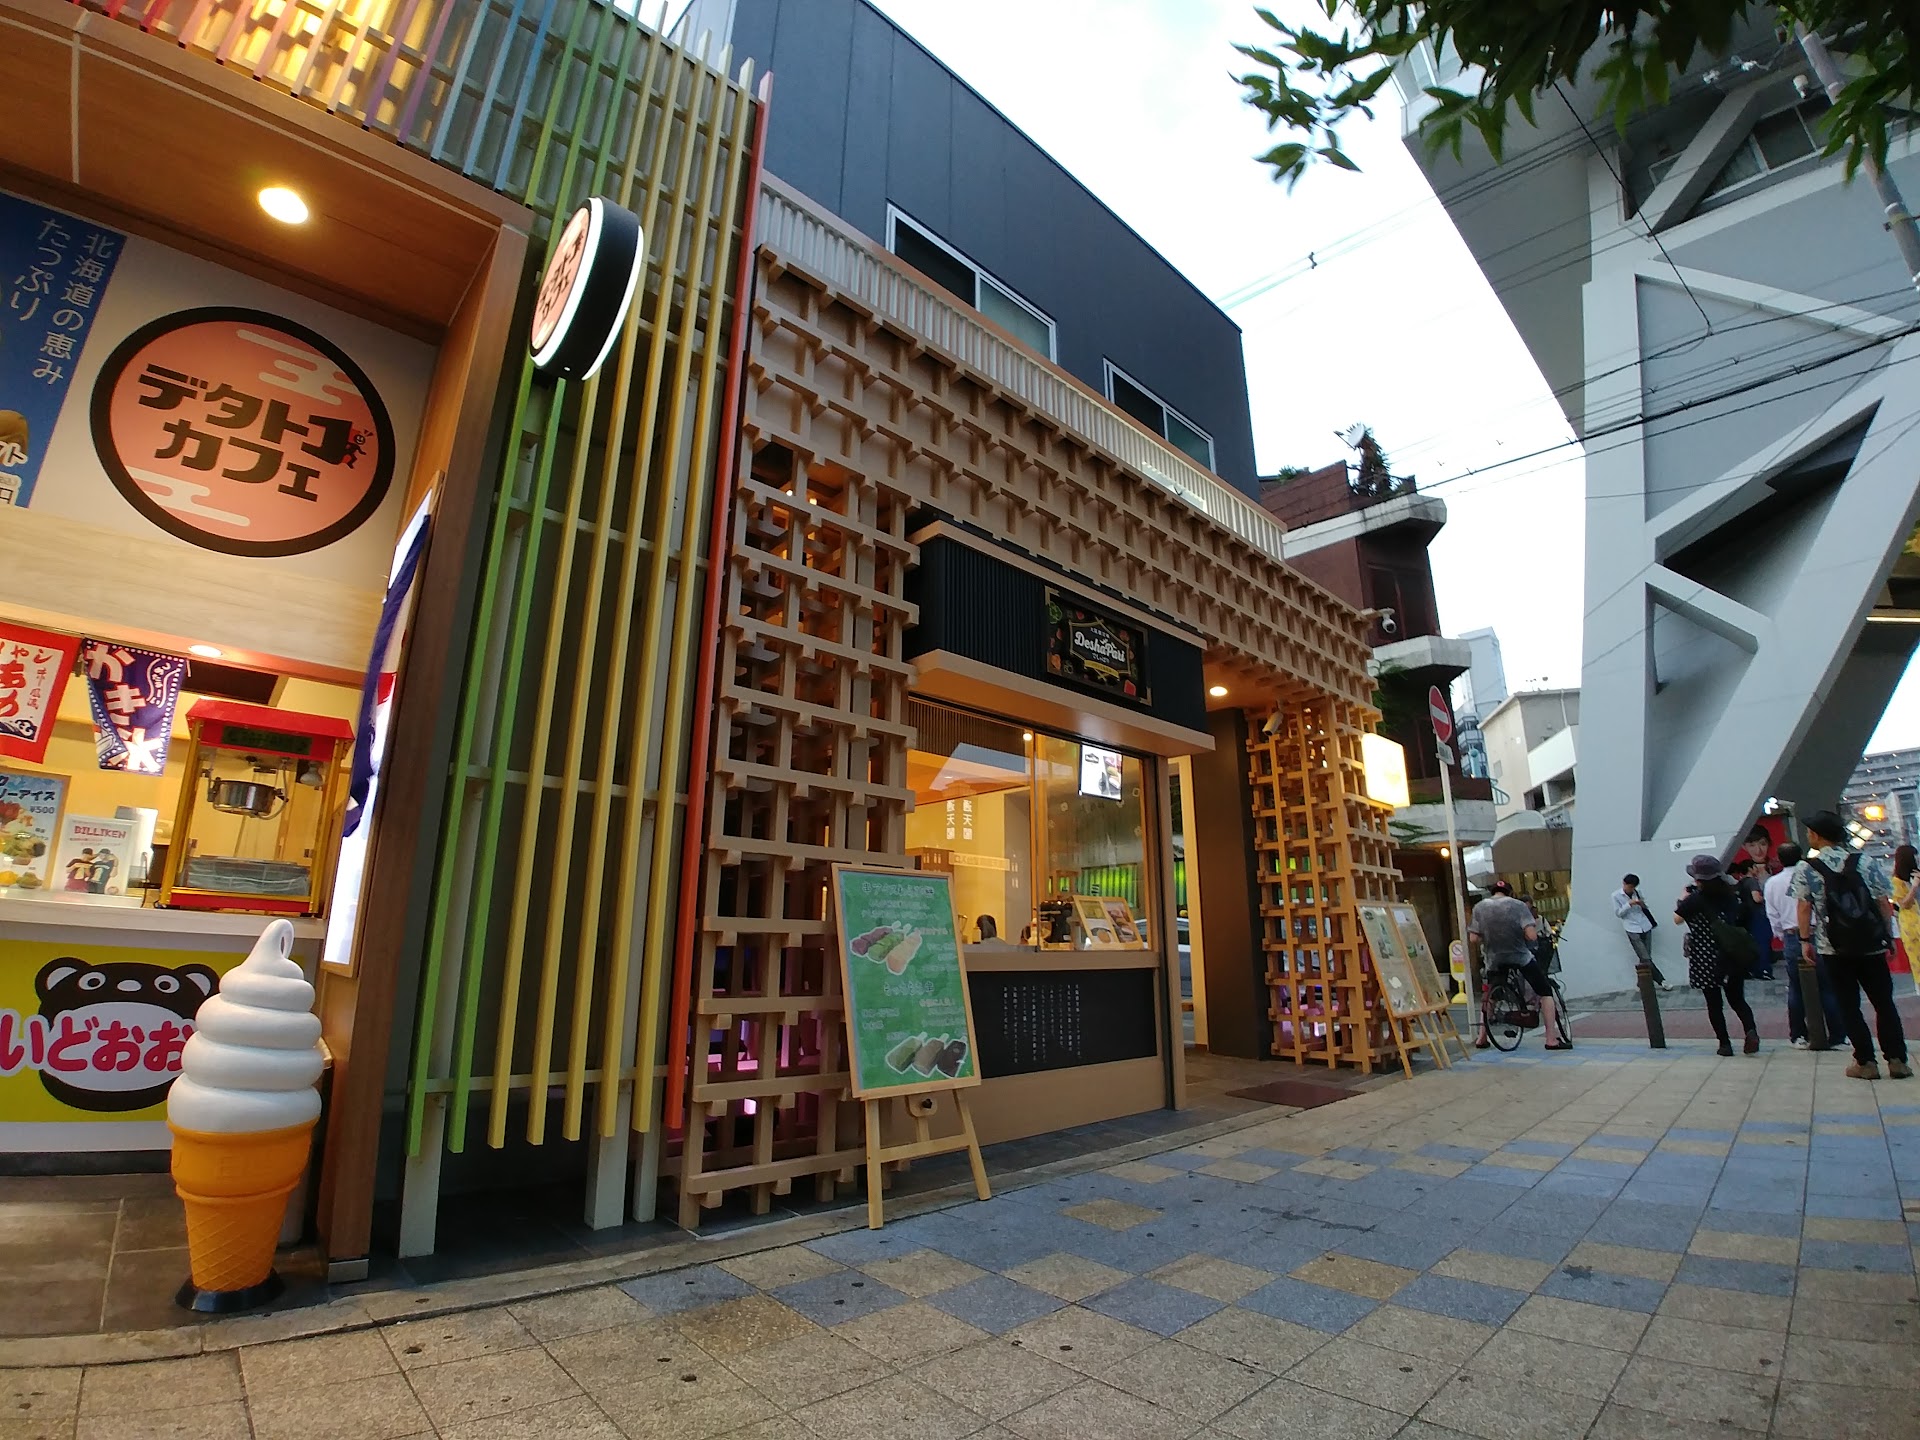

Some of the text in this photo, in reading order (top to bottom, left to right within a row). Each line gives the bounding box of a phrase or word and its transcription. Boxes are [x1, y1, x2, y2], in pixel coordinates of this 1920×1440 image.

[10, 218, 71, 321] たっぷり
[32, 233, 115, 385] 北海道の恵み
[138, 363, 353, 466] デタトコ
[154, 418, 320, 502] カフェ
[1074, 631, 1126, 663] DeshaPari
[86, 643, 164, 772] かき氷
[74, 825, 127, 839] BILLIKEN
